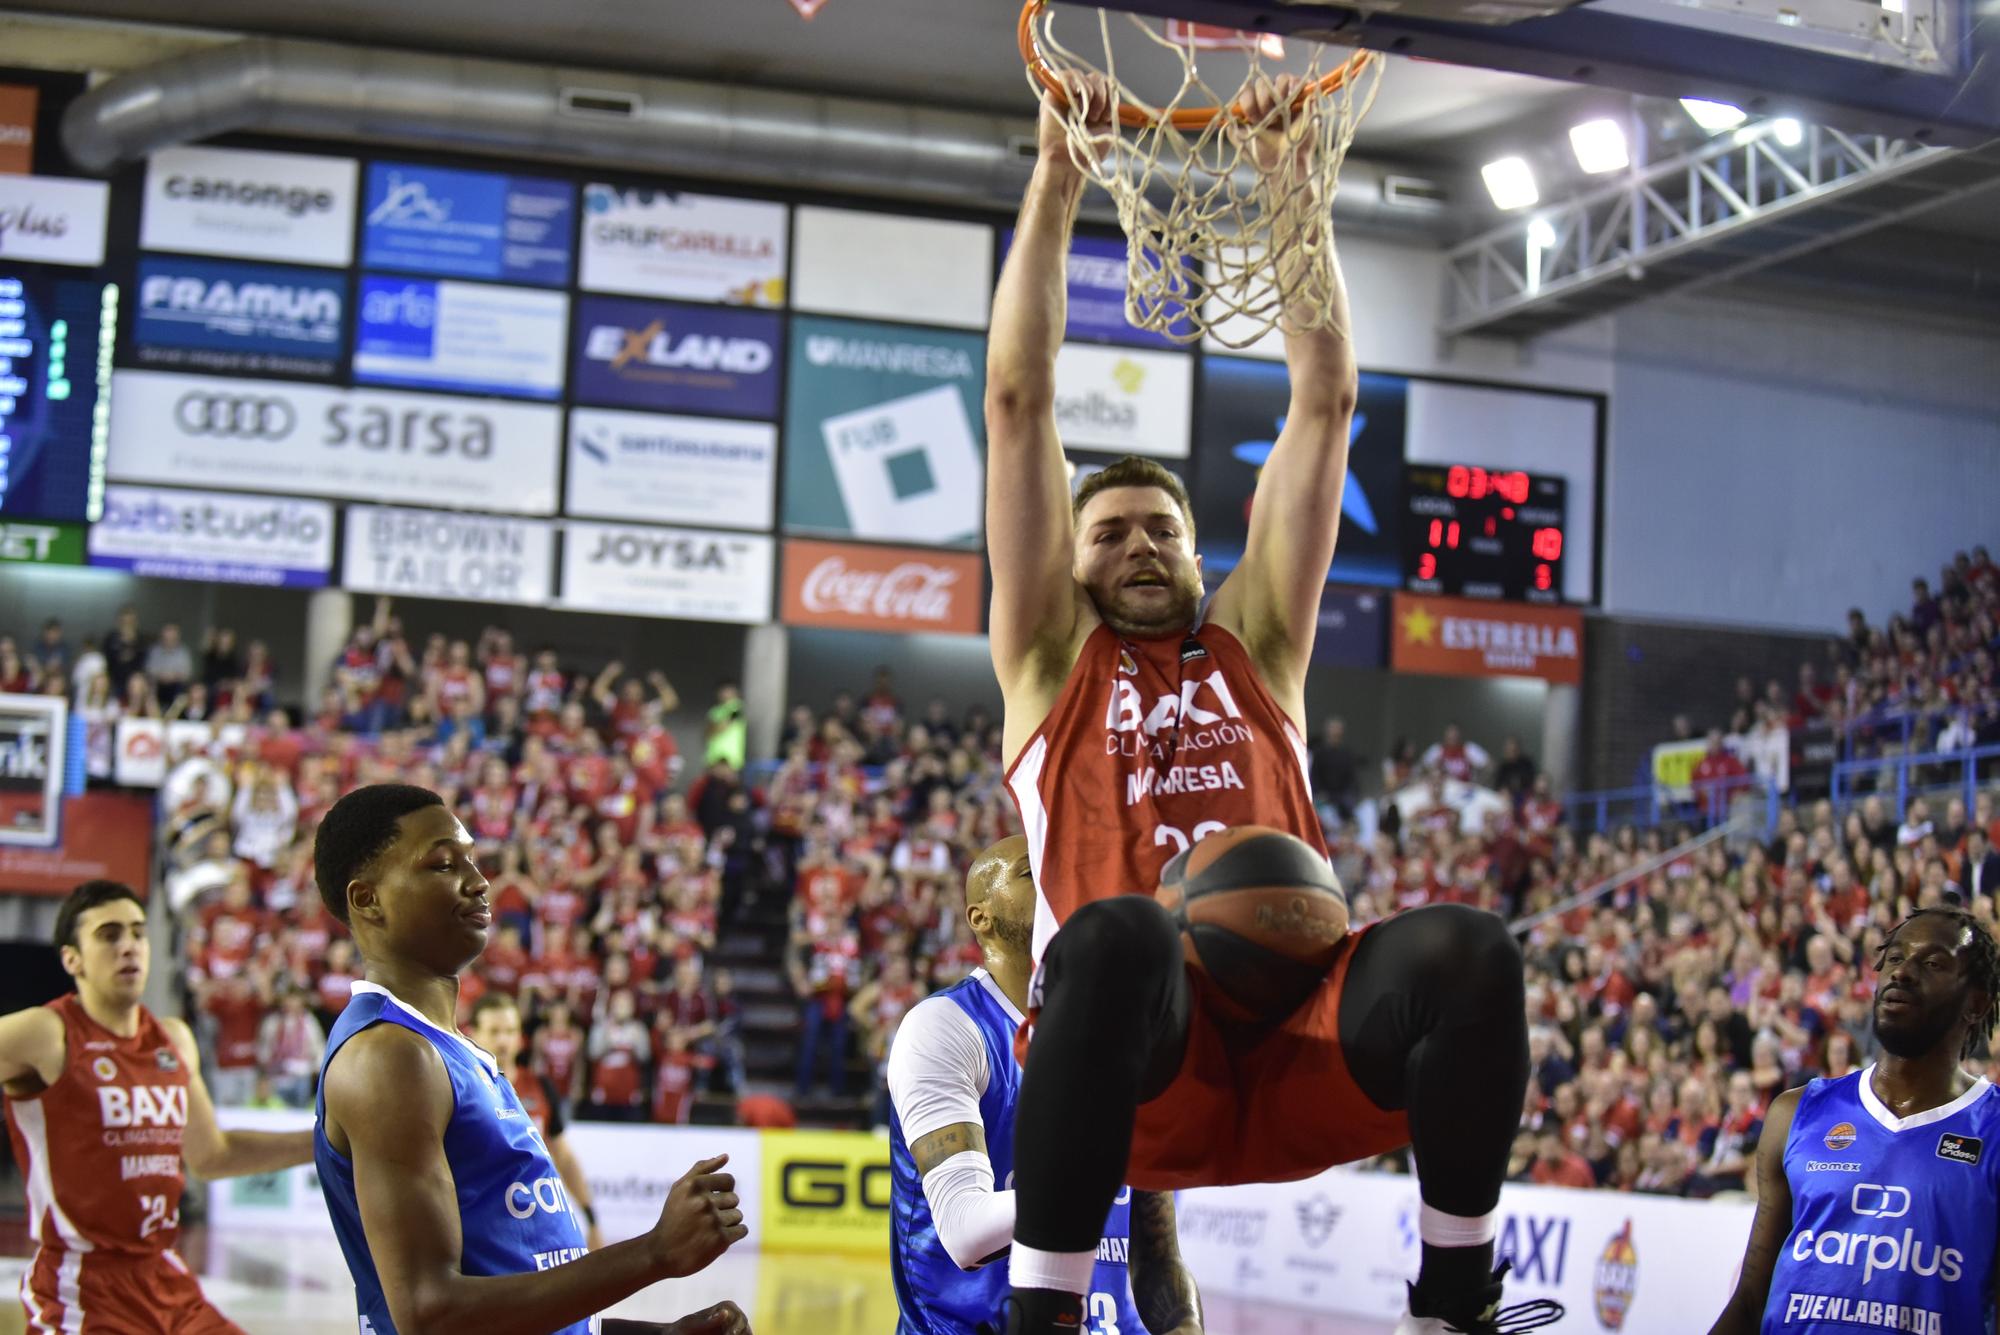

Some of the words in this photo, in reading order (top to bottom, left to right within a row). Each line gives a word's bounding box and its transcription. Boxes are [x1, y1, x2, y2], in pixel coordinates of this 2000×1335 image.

[163, 173, 335, 217] canonge
[585, 319, 774, 375] EXLAND
[323, 402, 494, 462] sarsa
[370, 508, 524, 555] BROWN
[369, 550, 524, 596] TAILOR
[1442, 616, 1579, 658] ESTRELLA
[97, 1085, 188, 1128] BAXI
[1806, 1161, 1862, 1173] Kromex
[1940, 1147, 1977, 1162] endesa
[1792, 1228, 1964, 1285] carplus
[1784, 1293, 1943, 1335] FUENLABRADA
